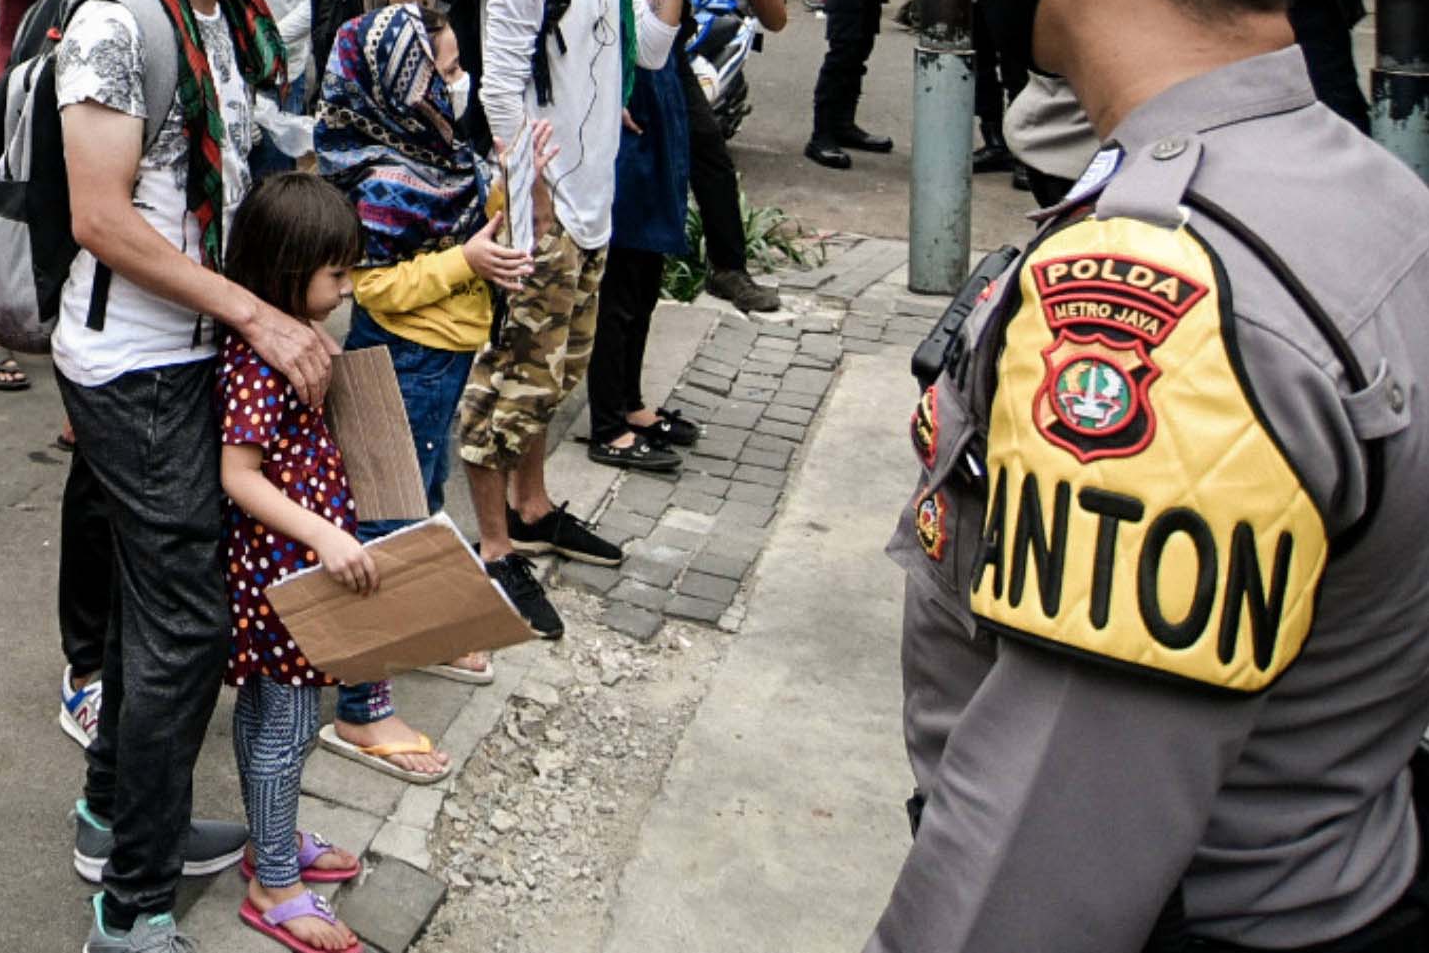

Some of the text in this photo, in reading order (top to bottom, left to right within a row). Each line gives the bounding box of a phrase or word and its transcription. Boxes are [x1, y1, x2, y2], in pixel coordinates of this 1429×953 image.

[1046, 256, 1182, 303] POLDA
[1055, 300, 1161, 336] METRO JAYA
[971, 465, 1293, 672] ANTON
